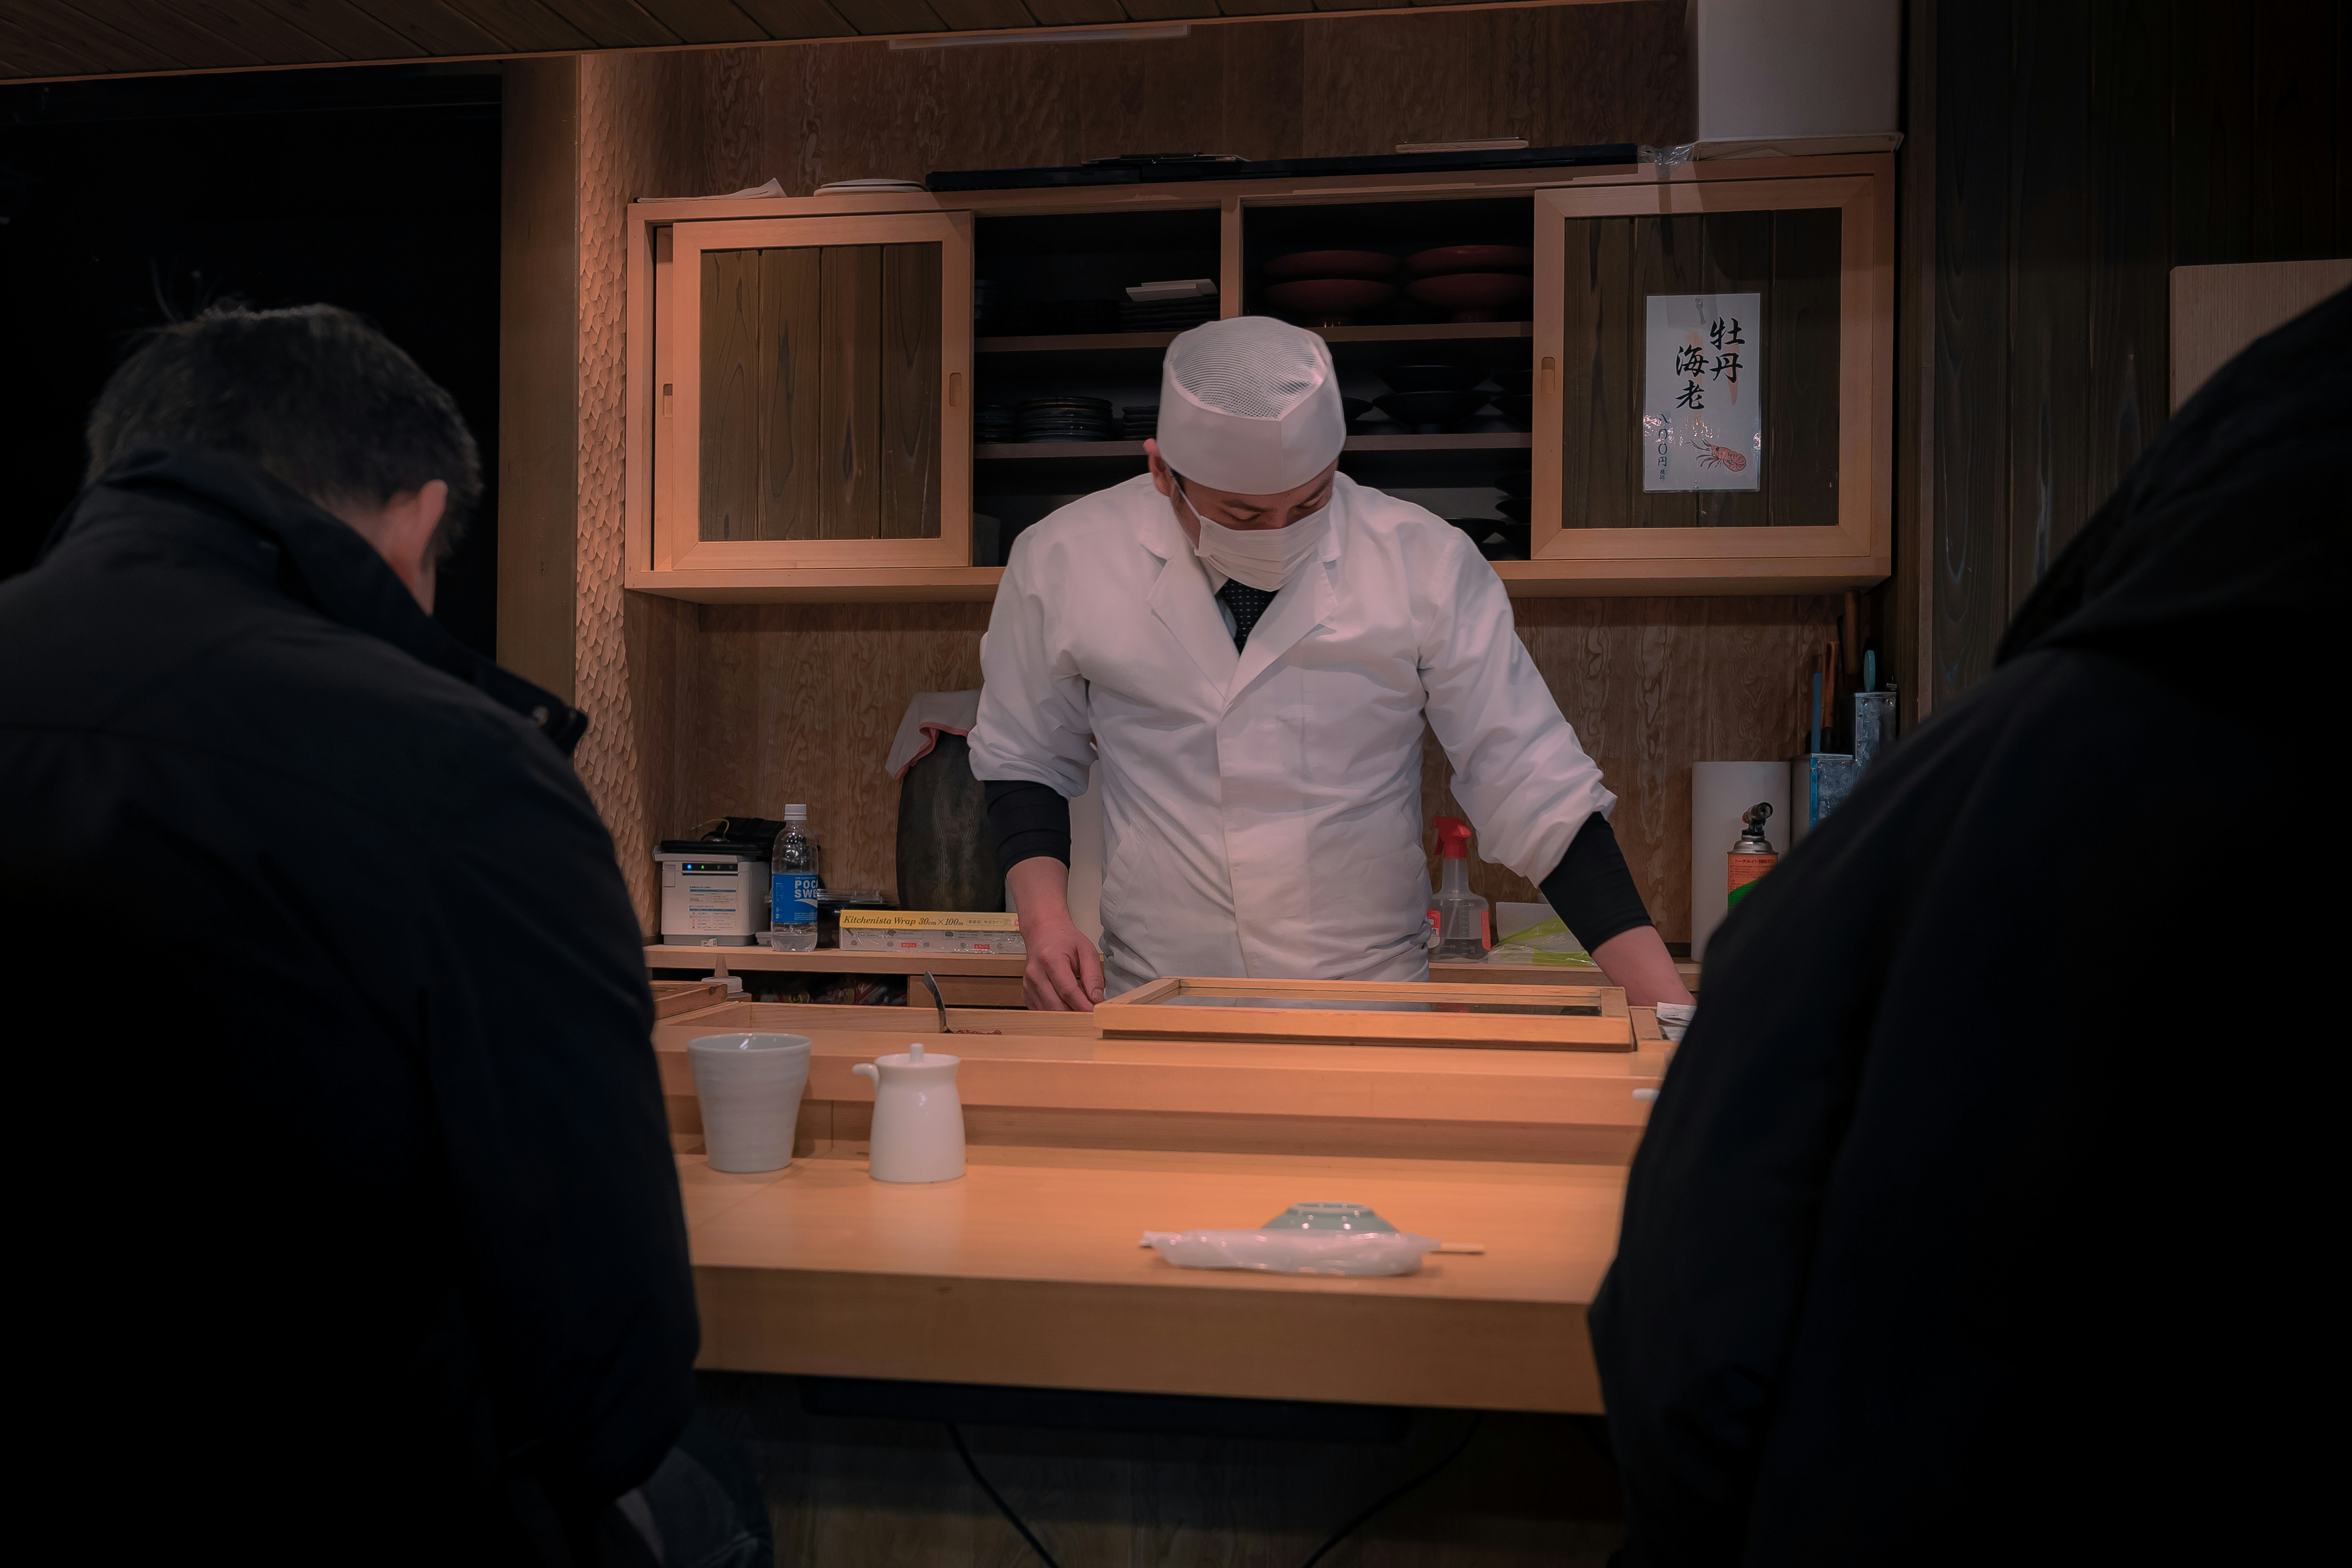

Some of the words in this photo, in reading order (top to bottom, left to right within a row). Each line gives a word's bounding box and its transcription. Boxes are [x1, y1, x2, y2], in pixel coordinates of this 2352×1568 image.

[1709, 316, 1746, 383] 牡丹
[1674, 343, 1709, 410] 海老
[795, 880, 818, 889] POC
[844, 916, 892, 924] Kitchenista
[894, 917, 916, 926] Wrap
